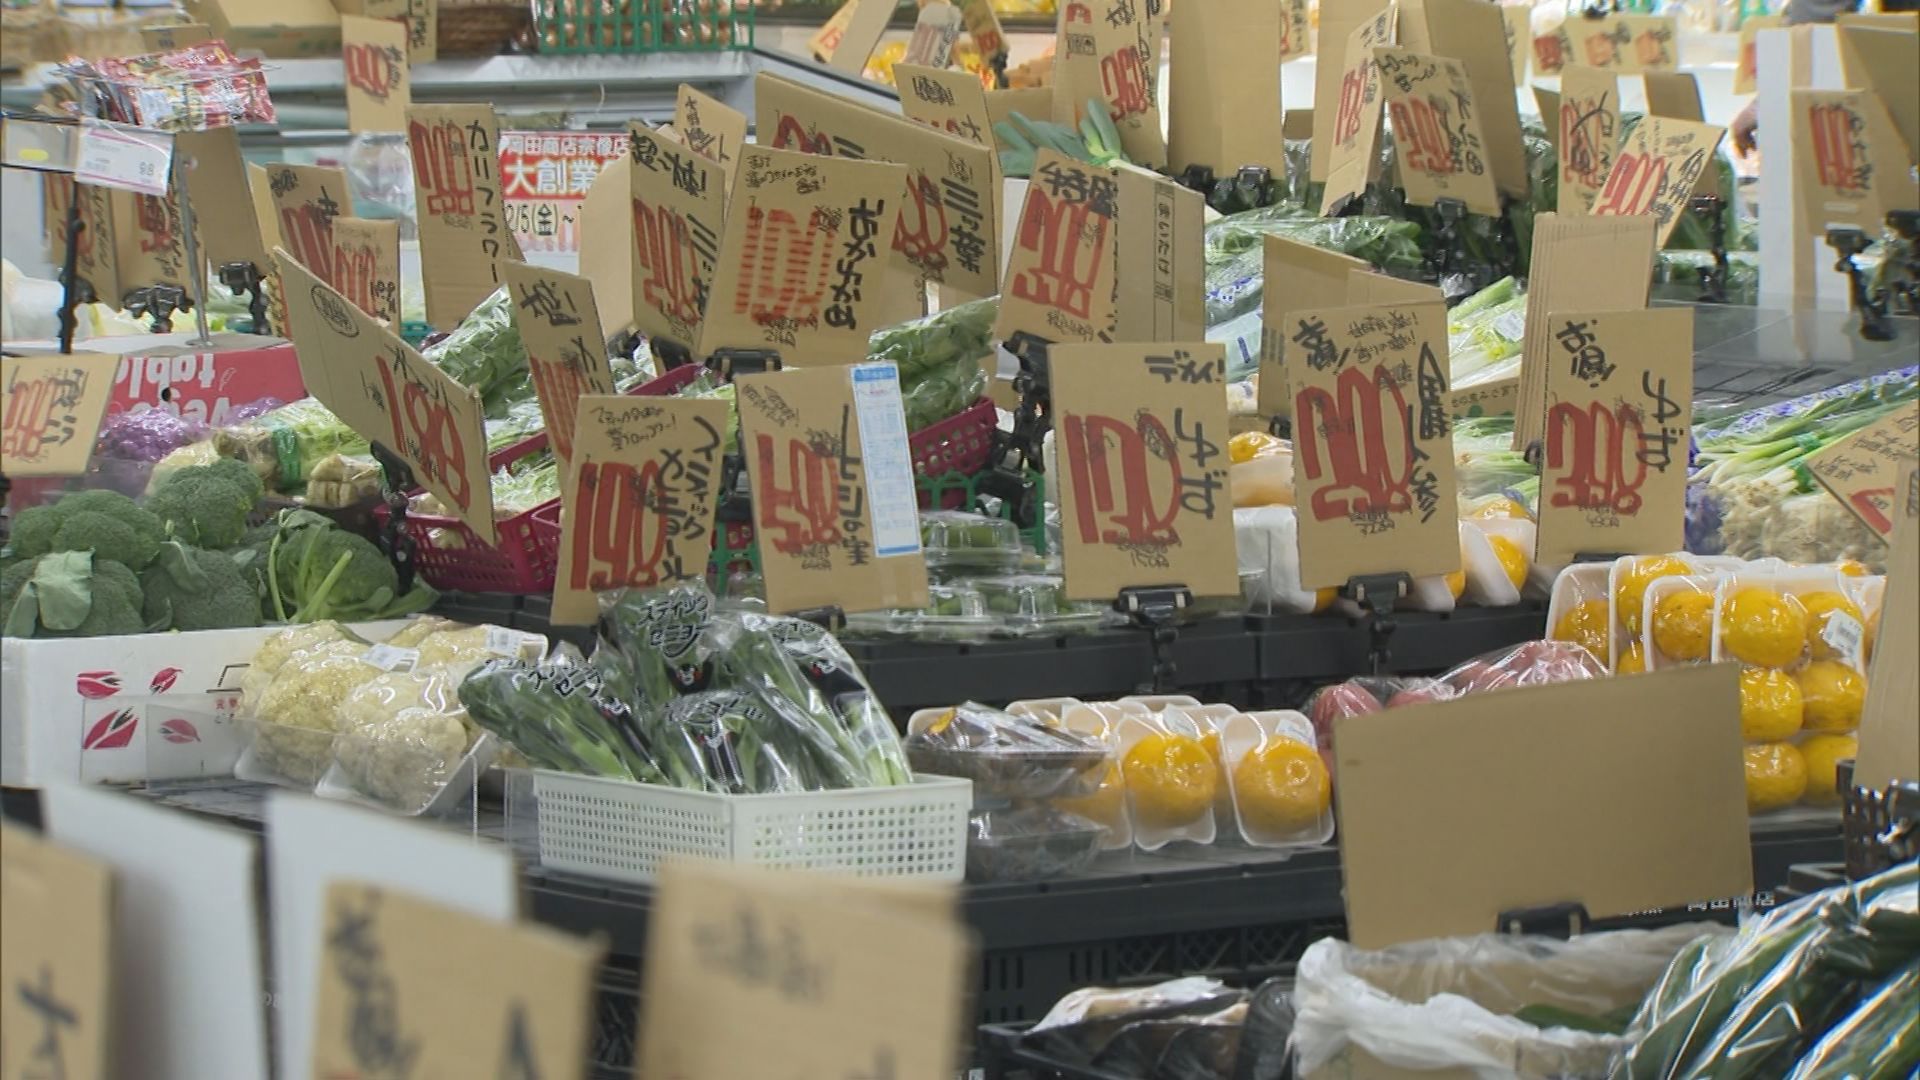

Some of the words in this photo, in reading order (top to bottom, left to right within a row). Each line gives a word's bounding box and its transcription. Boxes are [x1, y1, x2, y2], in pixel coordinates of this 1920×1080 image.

[466, 119, 500, 283] カリフラワー
[505, 158, 613, 195] 大創業
